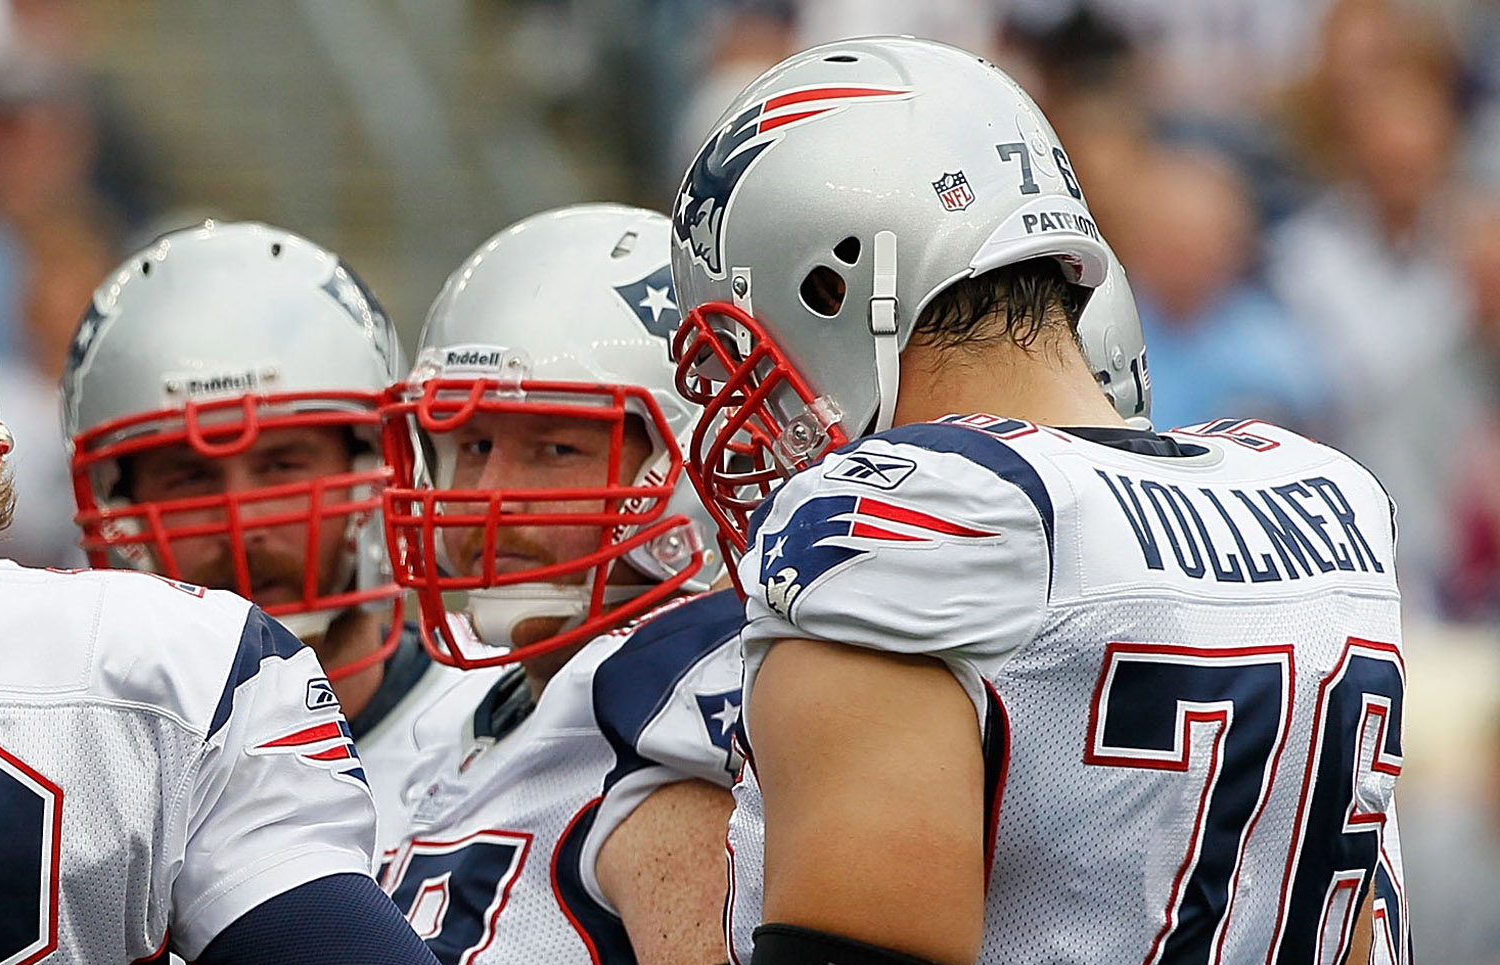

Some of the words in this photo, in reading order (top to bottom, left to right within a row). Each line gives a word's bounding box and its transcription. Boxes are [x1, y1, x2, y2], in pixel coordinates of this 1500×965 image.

[941, 186, 972, 209] NFL
[446, 352, 500, 366] Riddell
[1098, 467, 1383, 584] VOLLMER
